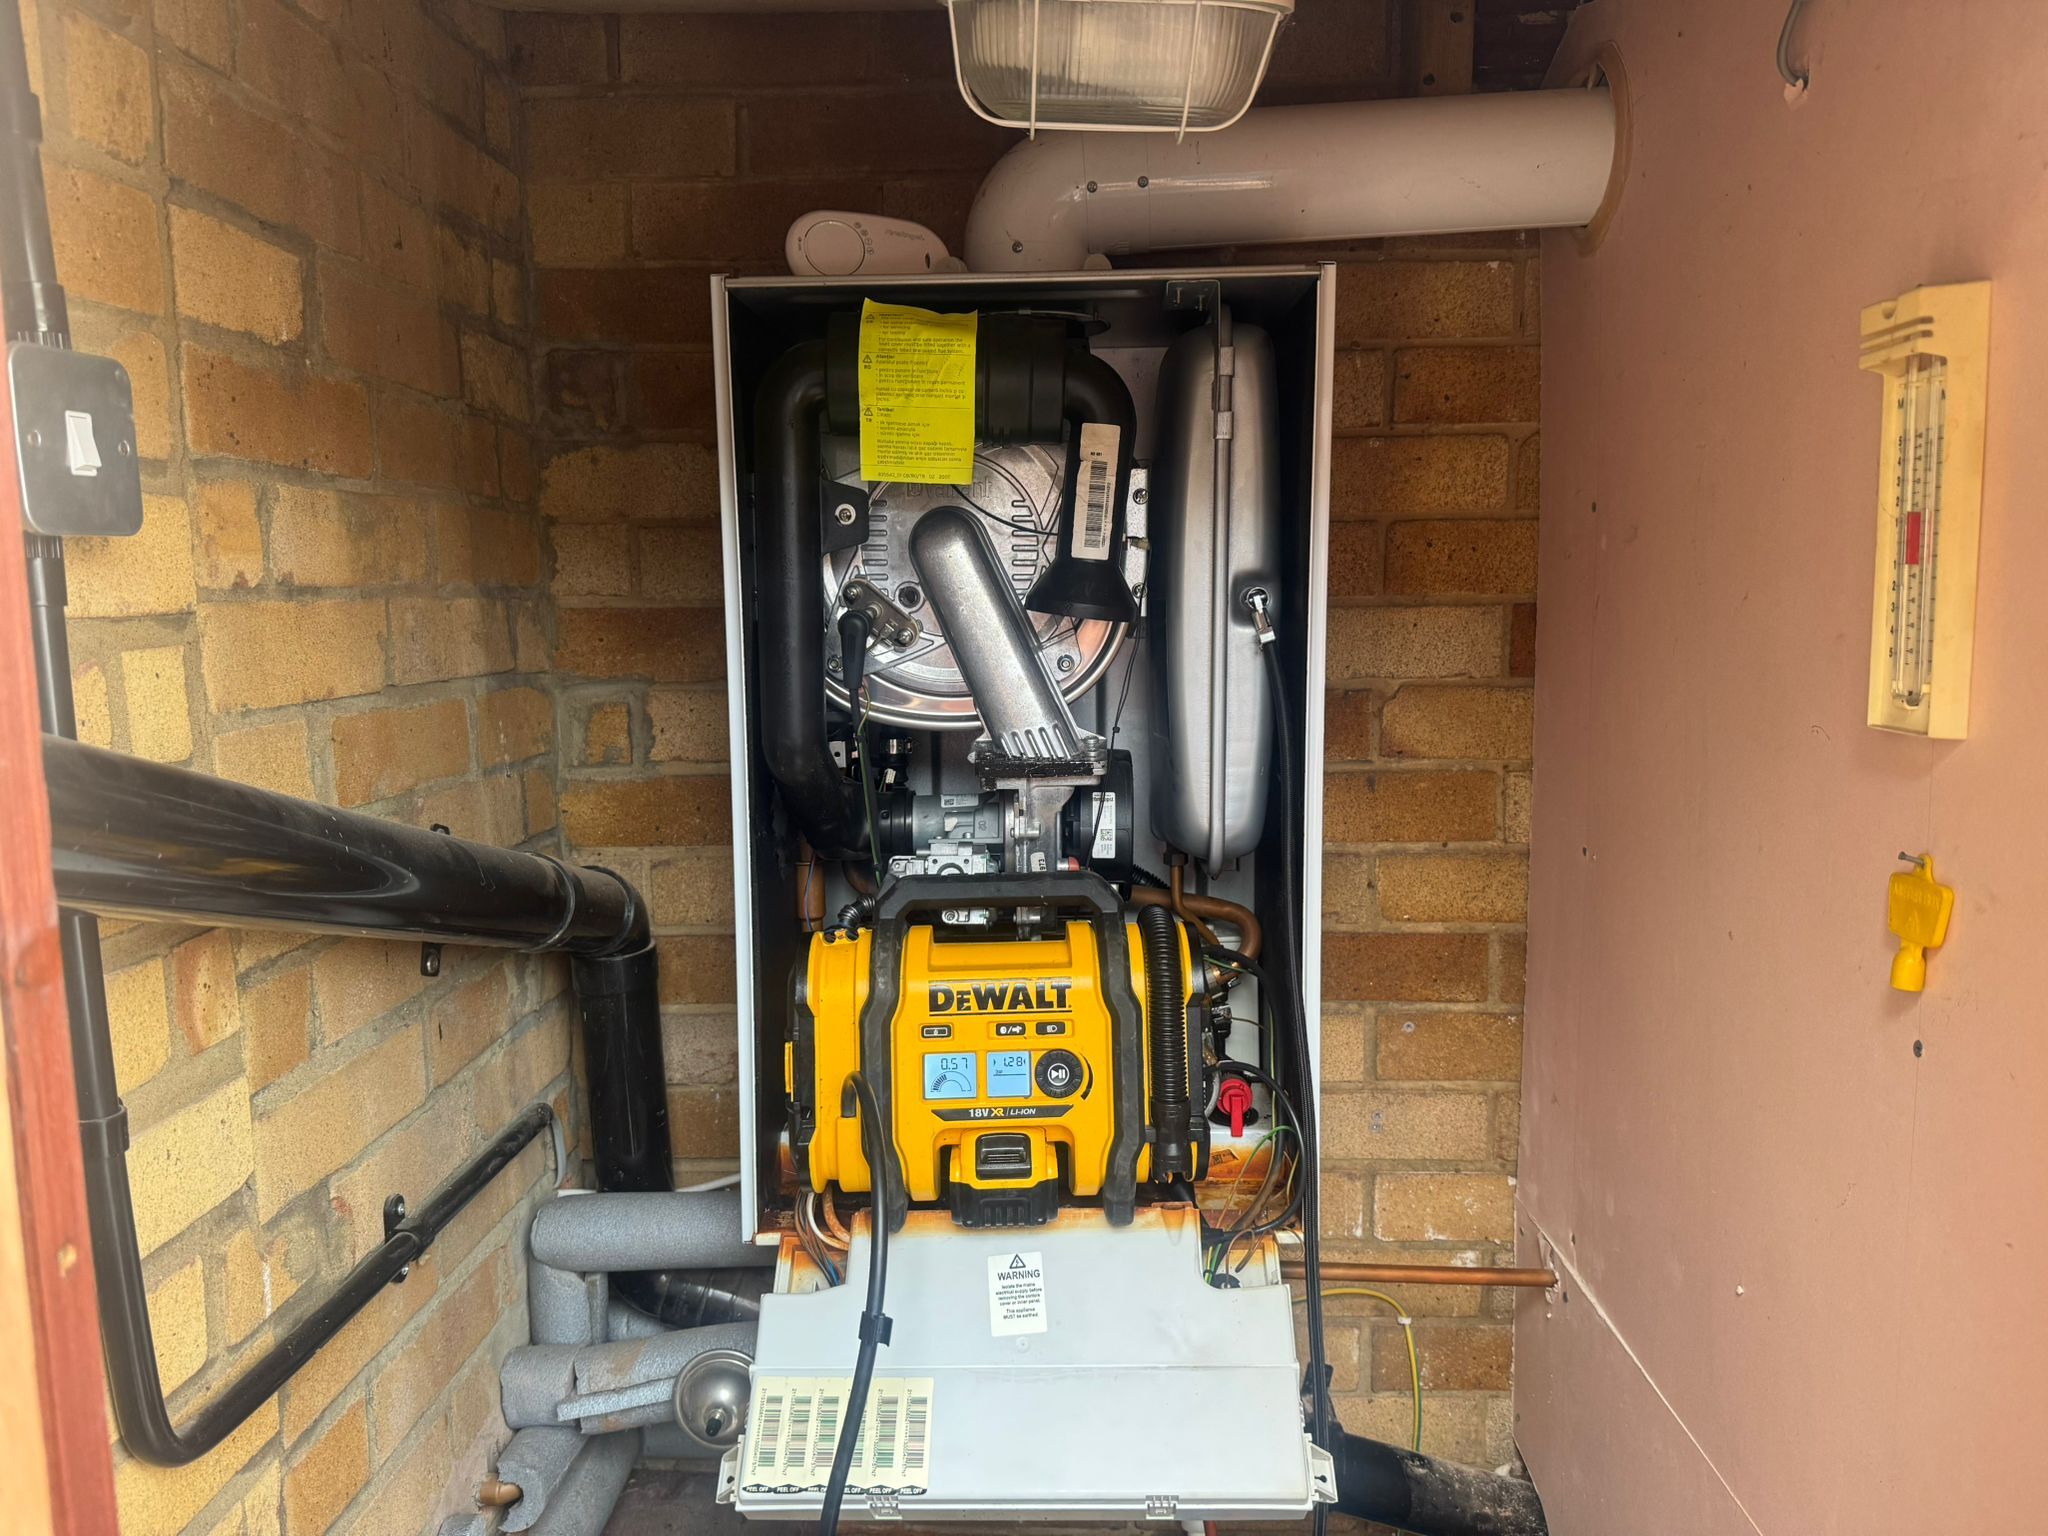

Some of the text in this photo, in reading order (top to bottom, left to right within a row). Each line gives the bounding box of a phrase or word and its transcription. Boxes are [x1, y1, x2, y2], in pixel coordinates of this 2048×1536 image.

[928, 982, 1072, 1013] DEWALT
[940, 1057, 969, 1071] 0.57
[968, 1106, 1037, 1118] 18V XR LI-ION
[997, 1269, 1041, 1281] WARNING
